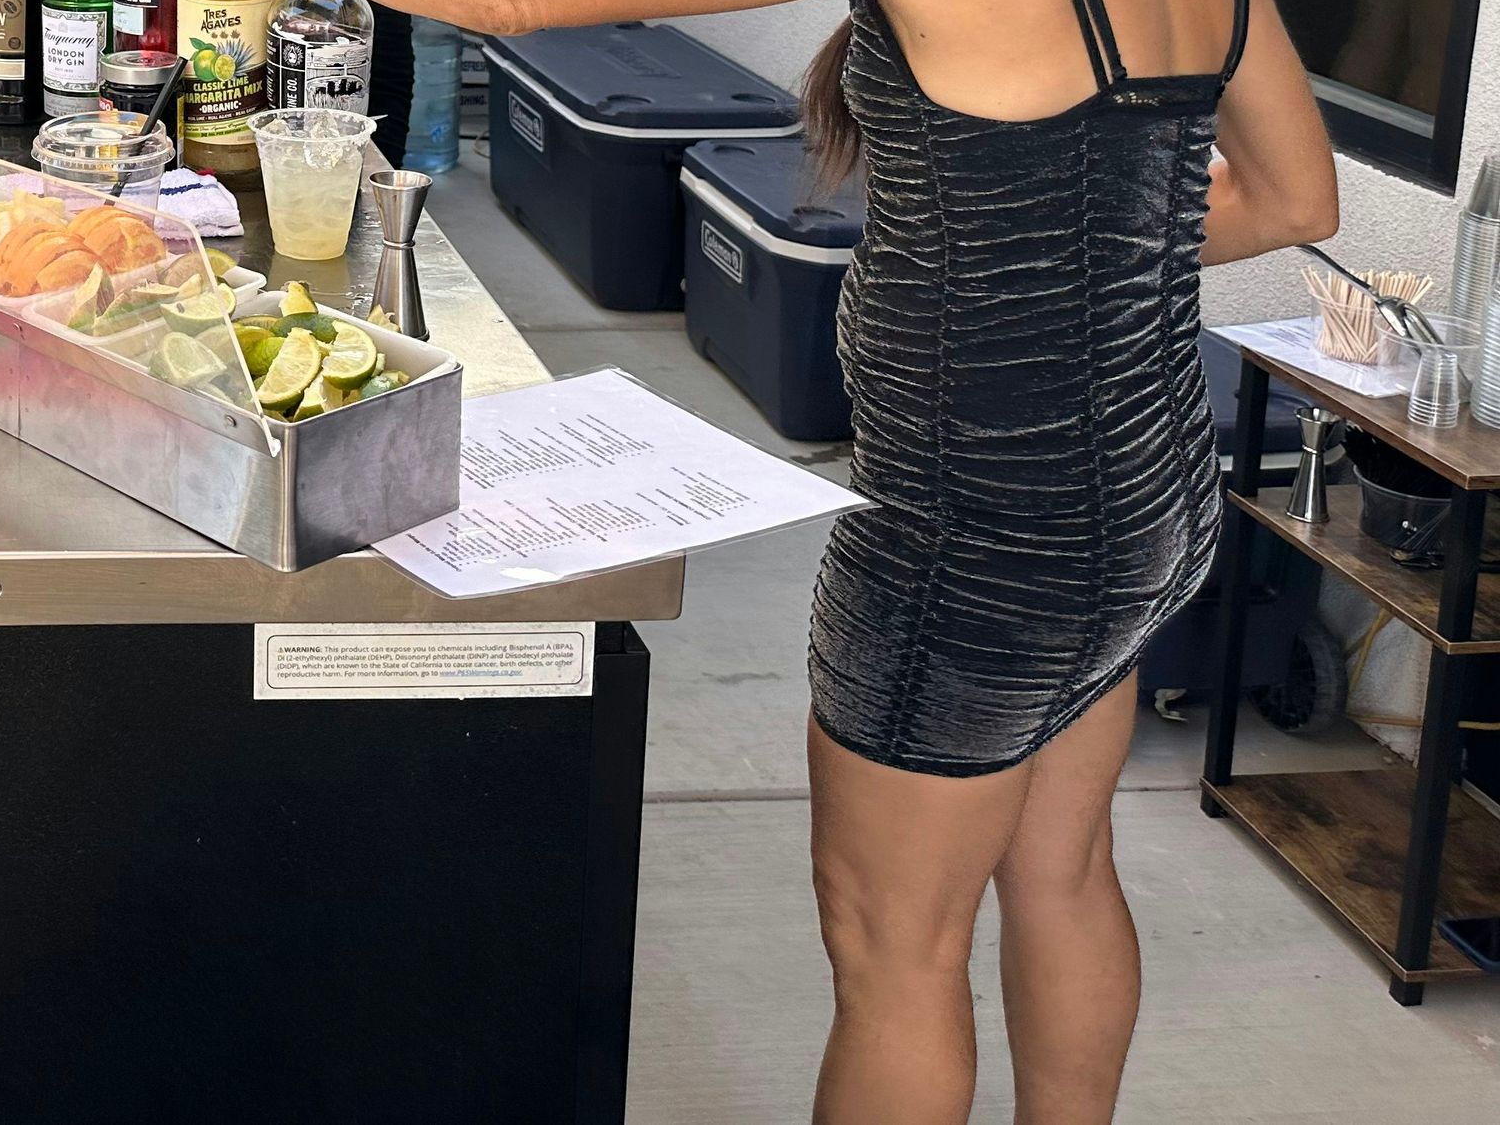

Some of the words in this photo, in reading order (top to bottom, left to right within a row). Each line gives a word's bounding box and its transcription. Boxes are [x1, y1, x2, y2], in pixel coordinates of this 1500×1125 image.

[203, 8, 227, 23] TRES
[200, 15, 242, 34] AGAVES
[44, 27, 95, 49] Tanqueray
[47, 46, 85, 58] LONDON
[47, 55, 63, 64] DRY
[66, 58, 85, 66] GIN
[193, 81, 226, 92] CLASSIC
[227, 75, 249, 88] LIME
[243, 80, 263, 97] MIX
[286, 77, 298, 92] CO.
[201, 100, 239, 114] ORGANIC
[286, 92, 298, 108] INE
[325, 645, 339, 653] This
[341, 645, 369, 654] product
[385, 646, 412, 654] expose
[413, 646, 427, 654] you
[437, 644, 473, 652] chemicals
[475, 644, 508, 653] including
[509, 643, 544, 653] Bisphenol
[334, 653, 367, 663] phthalate
[432, 652, 465, 662] phthalate
[490, 652, 504, 660] and
[541, 651, 574, 660] phthalate
[302, 662, 322, 670] which
[369, 661, 381, 669] the
[382, 661, 400, 669] State
[410, 661, 442, 669] California
[500, 660, 516, 668] birth
[554, 659, 573, 667] other
[277, 670, 321, 679] reproductive
